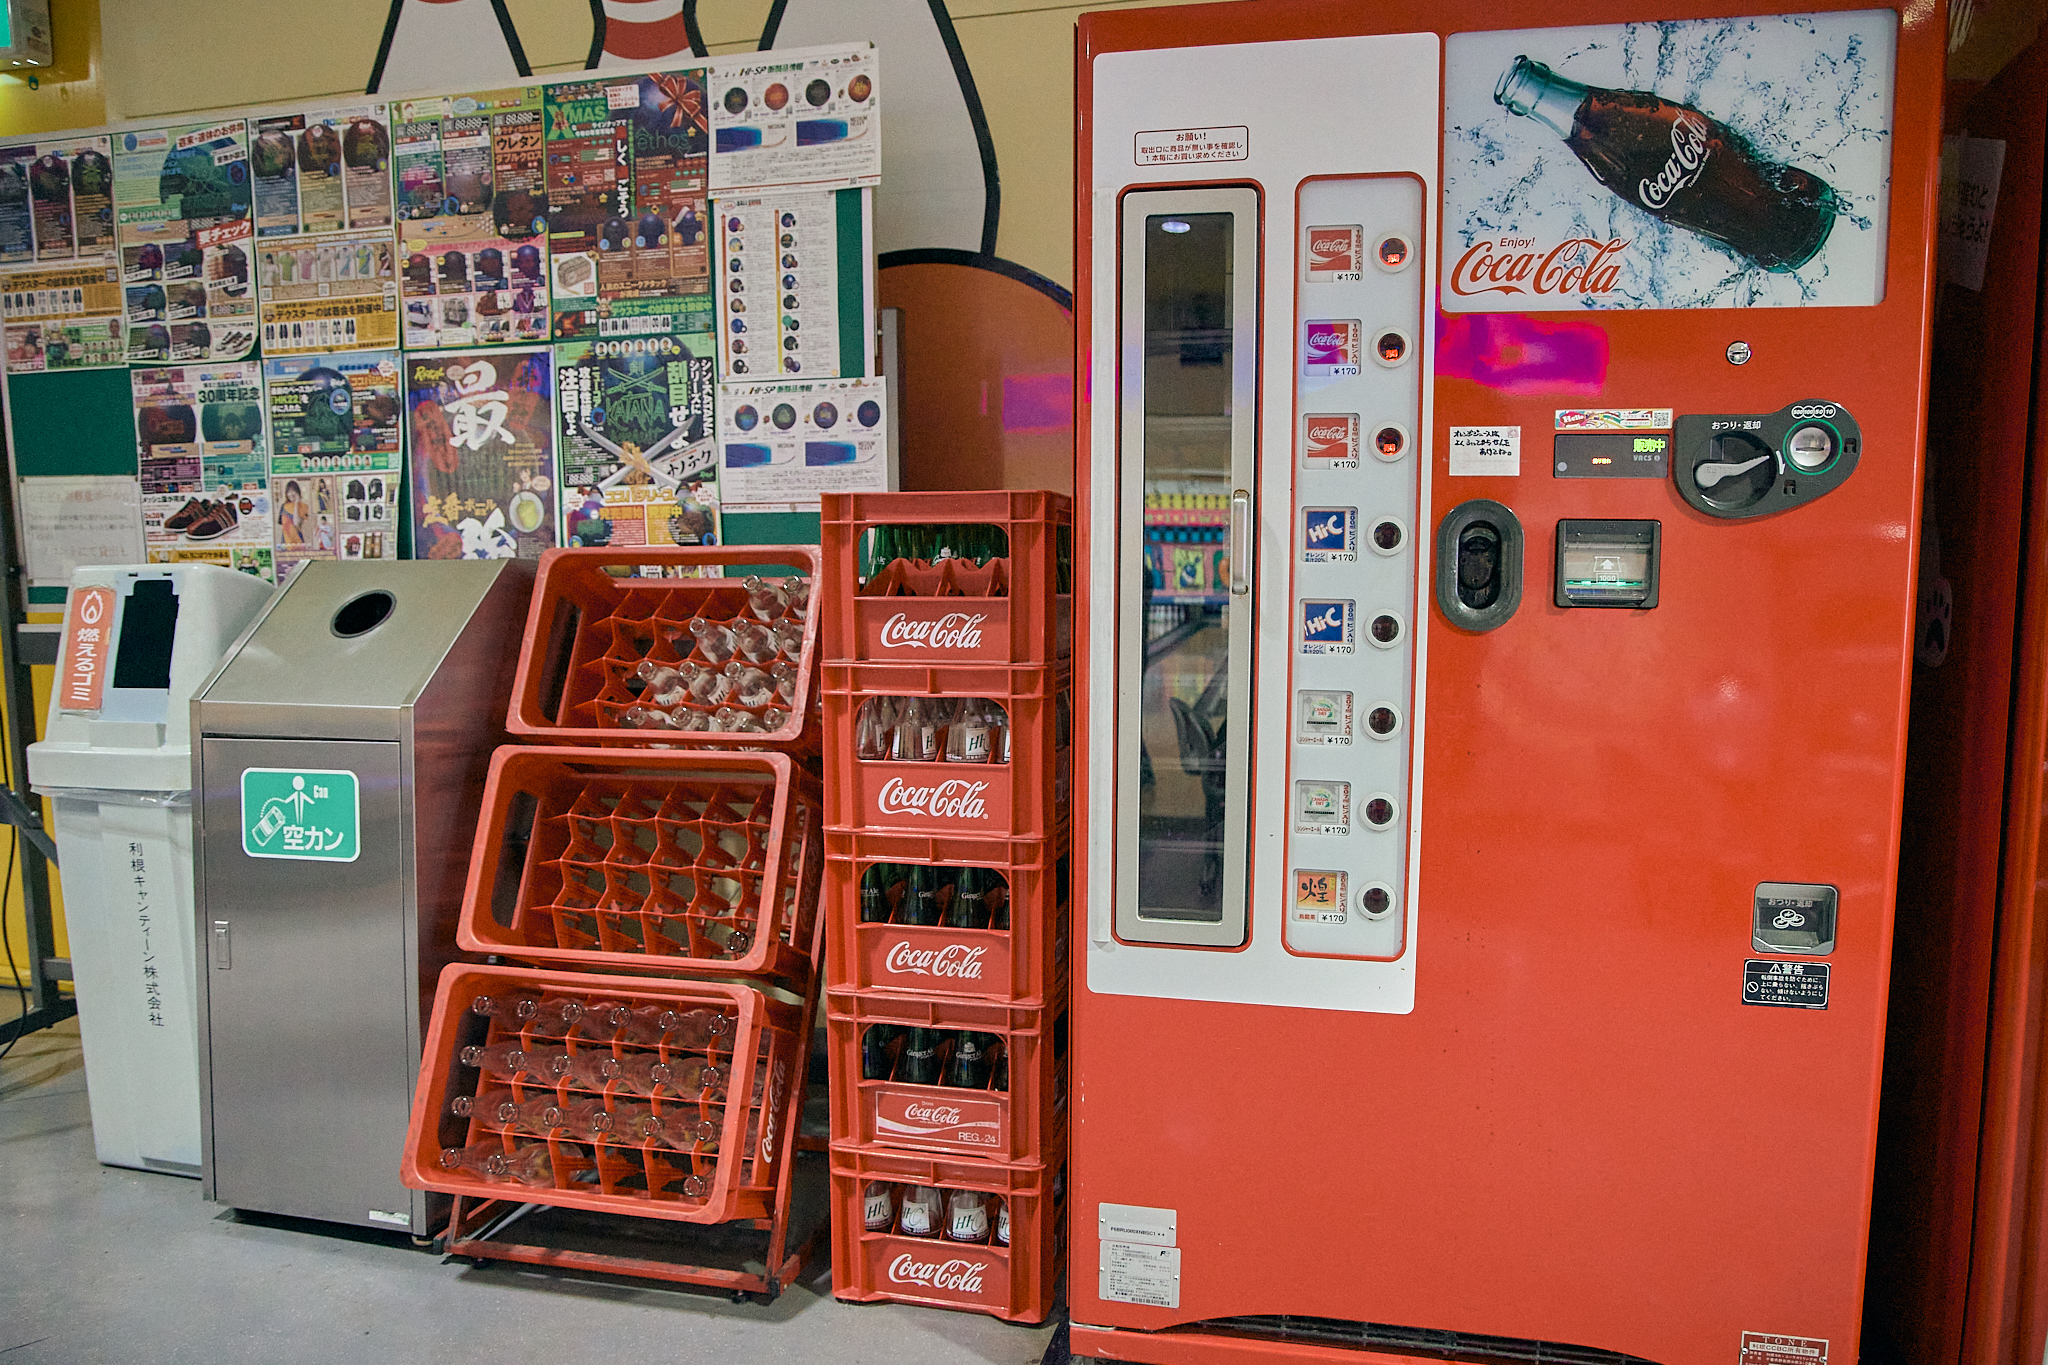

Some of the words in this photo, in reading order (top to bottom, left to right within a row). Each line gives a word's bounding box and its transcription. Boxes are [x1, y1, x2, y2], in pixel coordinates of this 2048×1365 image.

[496, 135, 540, 150] ウレタン
[1639, 106, 1708, 209] Coca-Cola
[1313, 239, 1350, 252] Coca-Cola
[1500, 237, 1535, 248] Enjoy!
[1450, 238, 1633, 296] Coca-Cola
[1337, 273, 1360, 281] ¥170
[1309, 333, 1347, 346] Coca-Cola
[1333, 367, 1357, 375] ¥170
[1711, 420, 1761, 430] おつり・返却
[1310, 427, 1346, 440] Coca-Cola
[1633, 437, 1666, 453] 販売中
[1333, 460, 1357, 468] ¥170
[1308, 514, 1344, 543] Hi-C
[1331, 553, 1354, 561] ¥170
[1306, 607, 1342, 635] Hi-C
[880, 612, 988, 649] Coca-Cola
[1329, 645, 1352, 653] ¥170
[71, 628, 101, 701] 燃えるゴミ
[1327, 736, 1350, 744] ¥170
[878, 777, 989, 818] Coca-Cola
[1324, 826, 1347, 834] ¥170
[283, 824, 344, 851] 空カン
[1322, 914, 1344, 922] ¥170
[128, 842, 164, 1027] 利根キャンティーン株式会社
[886, 941, 988, 979] Coca-Cola
[905, 1103, 962, 1125] Coca-Cola
[888, 1253, 988, 1294] Coca-Cola
[1762, 1336, 1808, 1348] TONE
